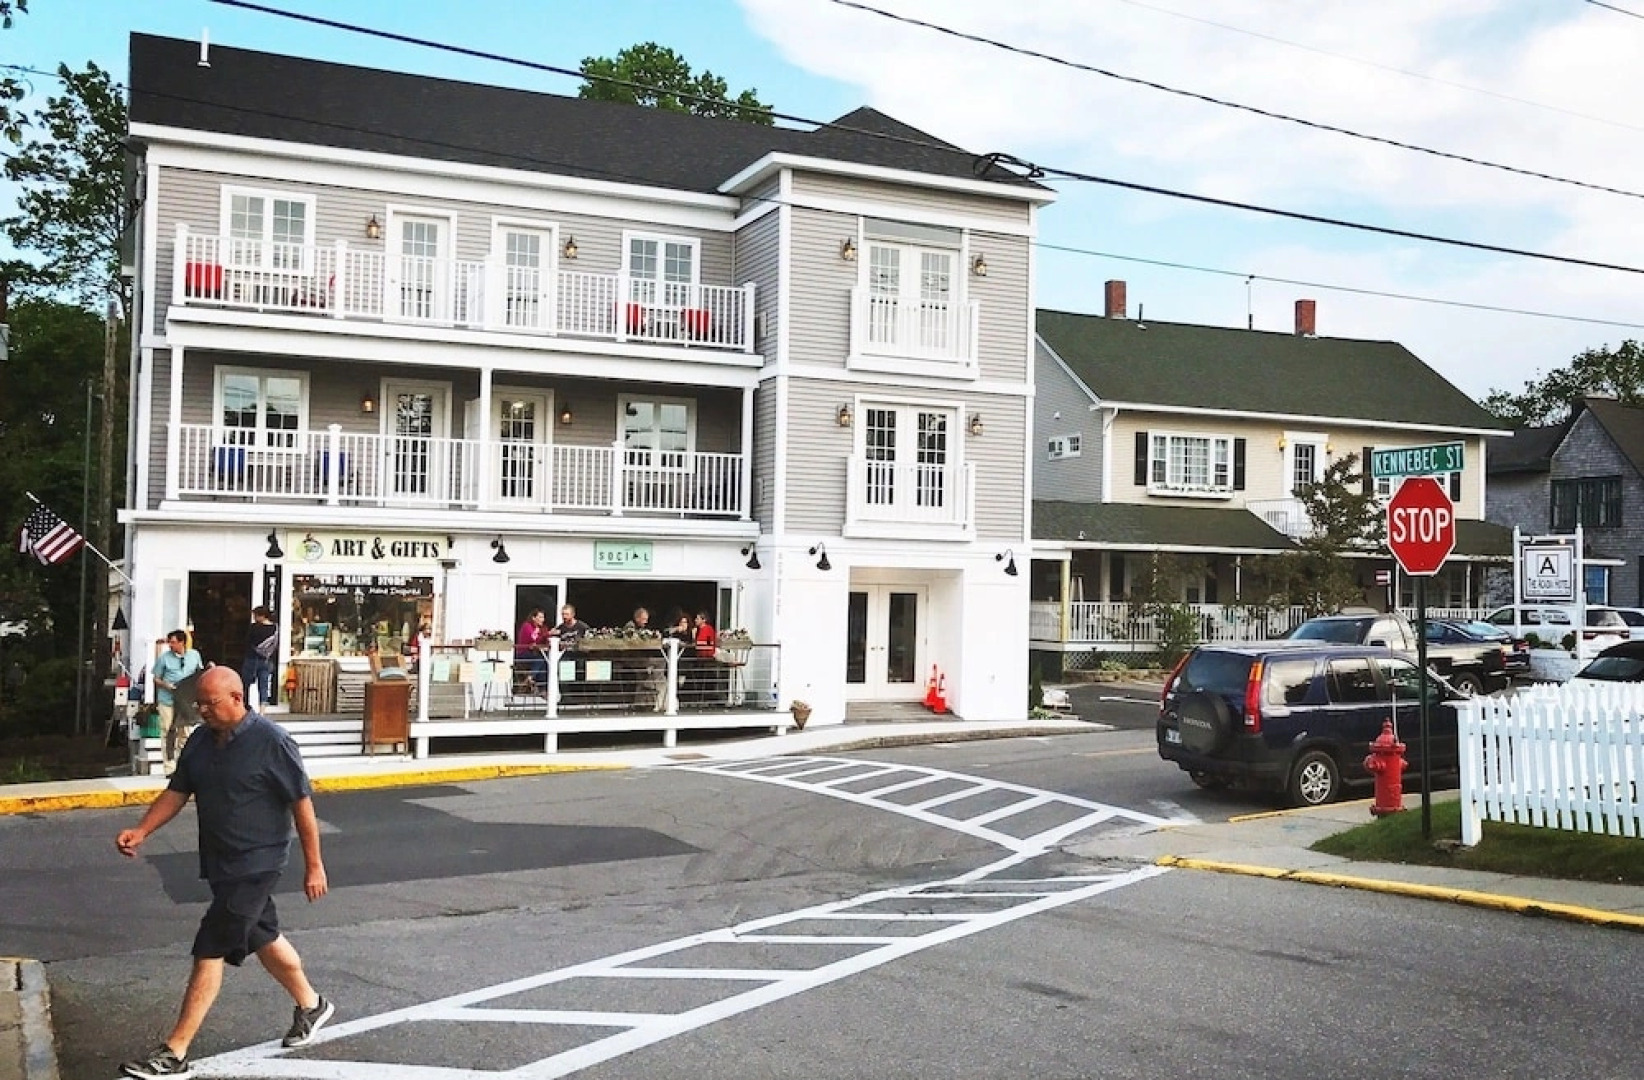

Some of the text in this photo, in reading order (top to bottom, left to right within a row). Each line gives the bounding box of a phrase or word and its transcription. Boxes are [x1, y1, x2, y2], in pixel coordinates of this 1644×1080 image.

[1375, 446, 1461, 474] KENNEBEC ST
[1392, 507, 1450, 543] STOP
[331, 538, 367, 556] ART
[371, 536, 386, 560] &
[391, 540, 440, 558] GIFTS
[1540, 556, 1556, 574] A
[1183, 716, 1212, 729] HONDA
